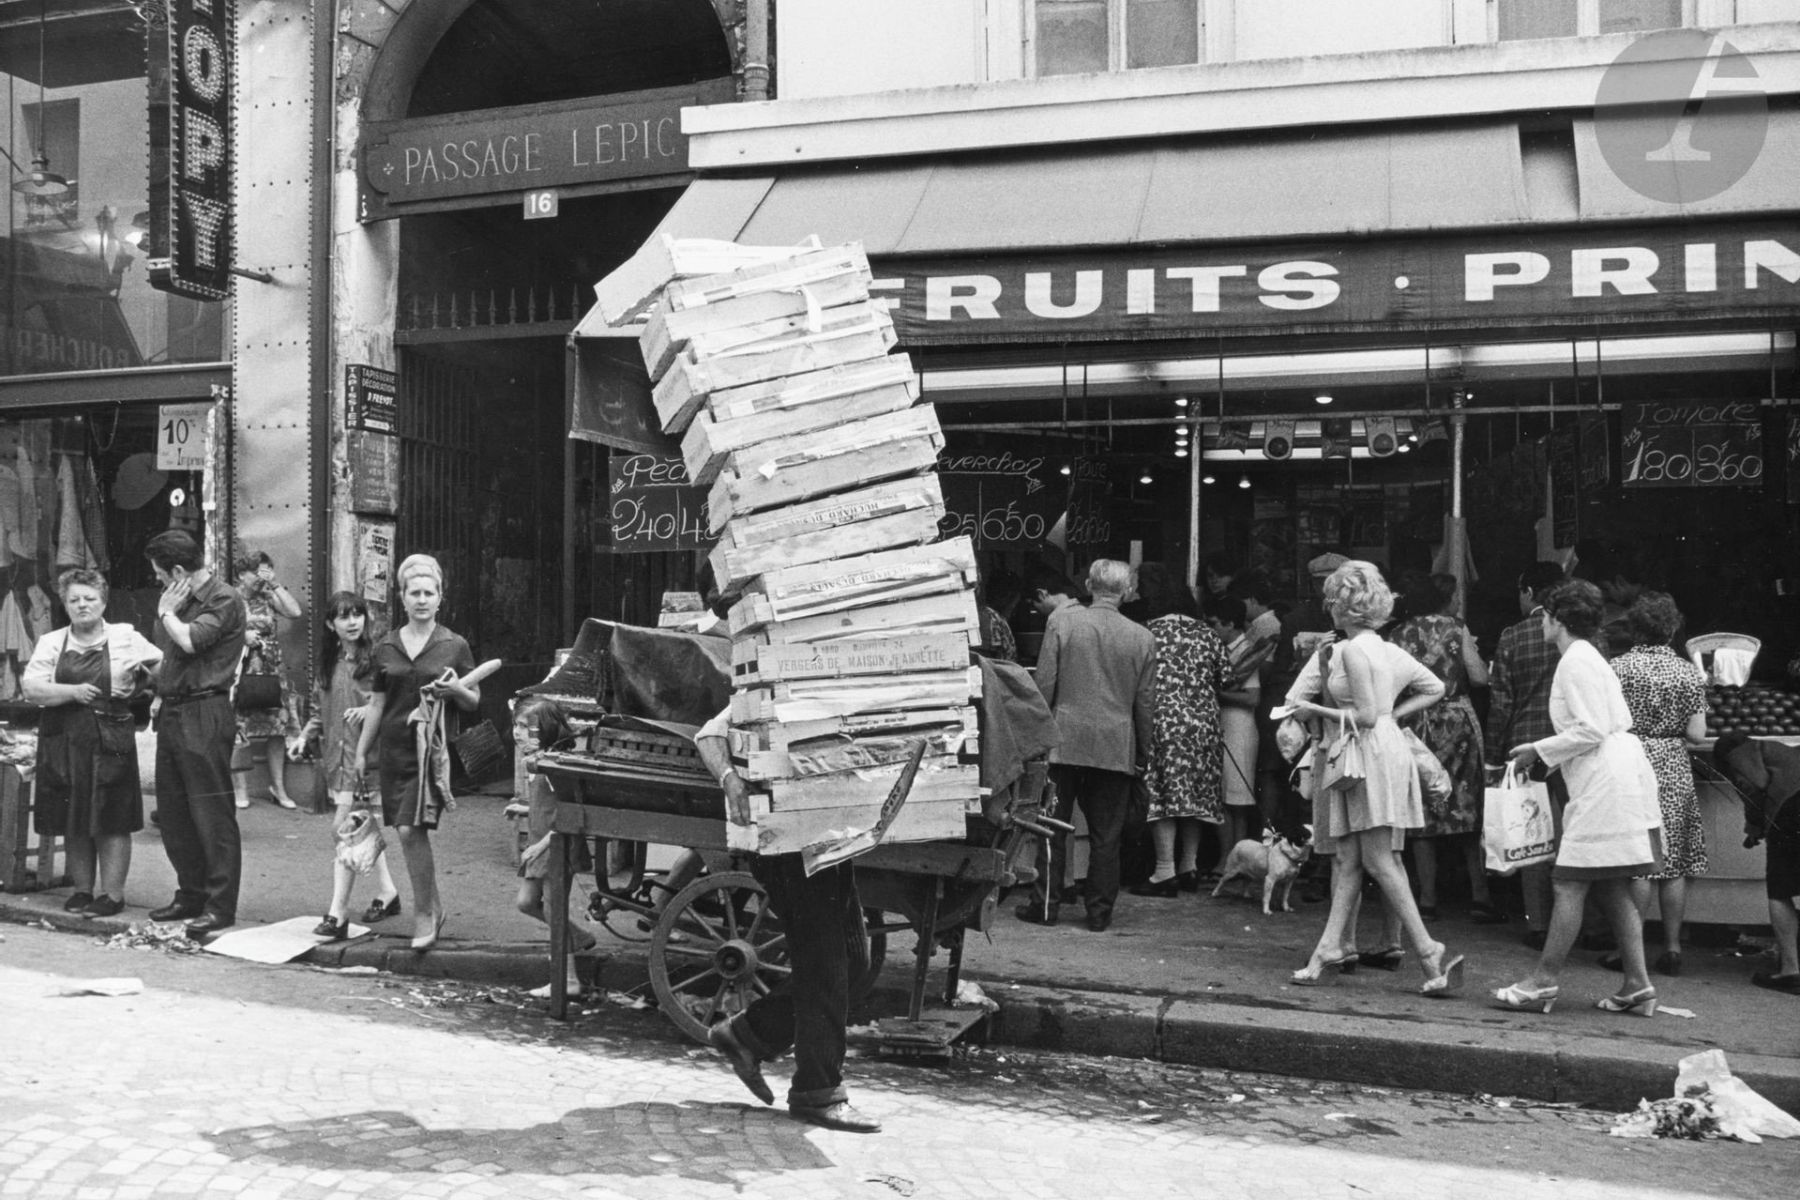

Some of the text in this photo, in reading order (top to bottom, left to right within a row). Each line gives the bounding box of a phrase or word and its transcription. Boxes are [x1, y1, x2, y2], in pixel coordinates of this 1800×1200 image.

[404, 117, 676, 185] PASSAGE LEPIC
[529, 192, 552, 214] 16
[827, 656, 840, 670] DE
[847, 653, 885, 669] MAISON
